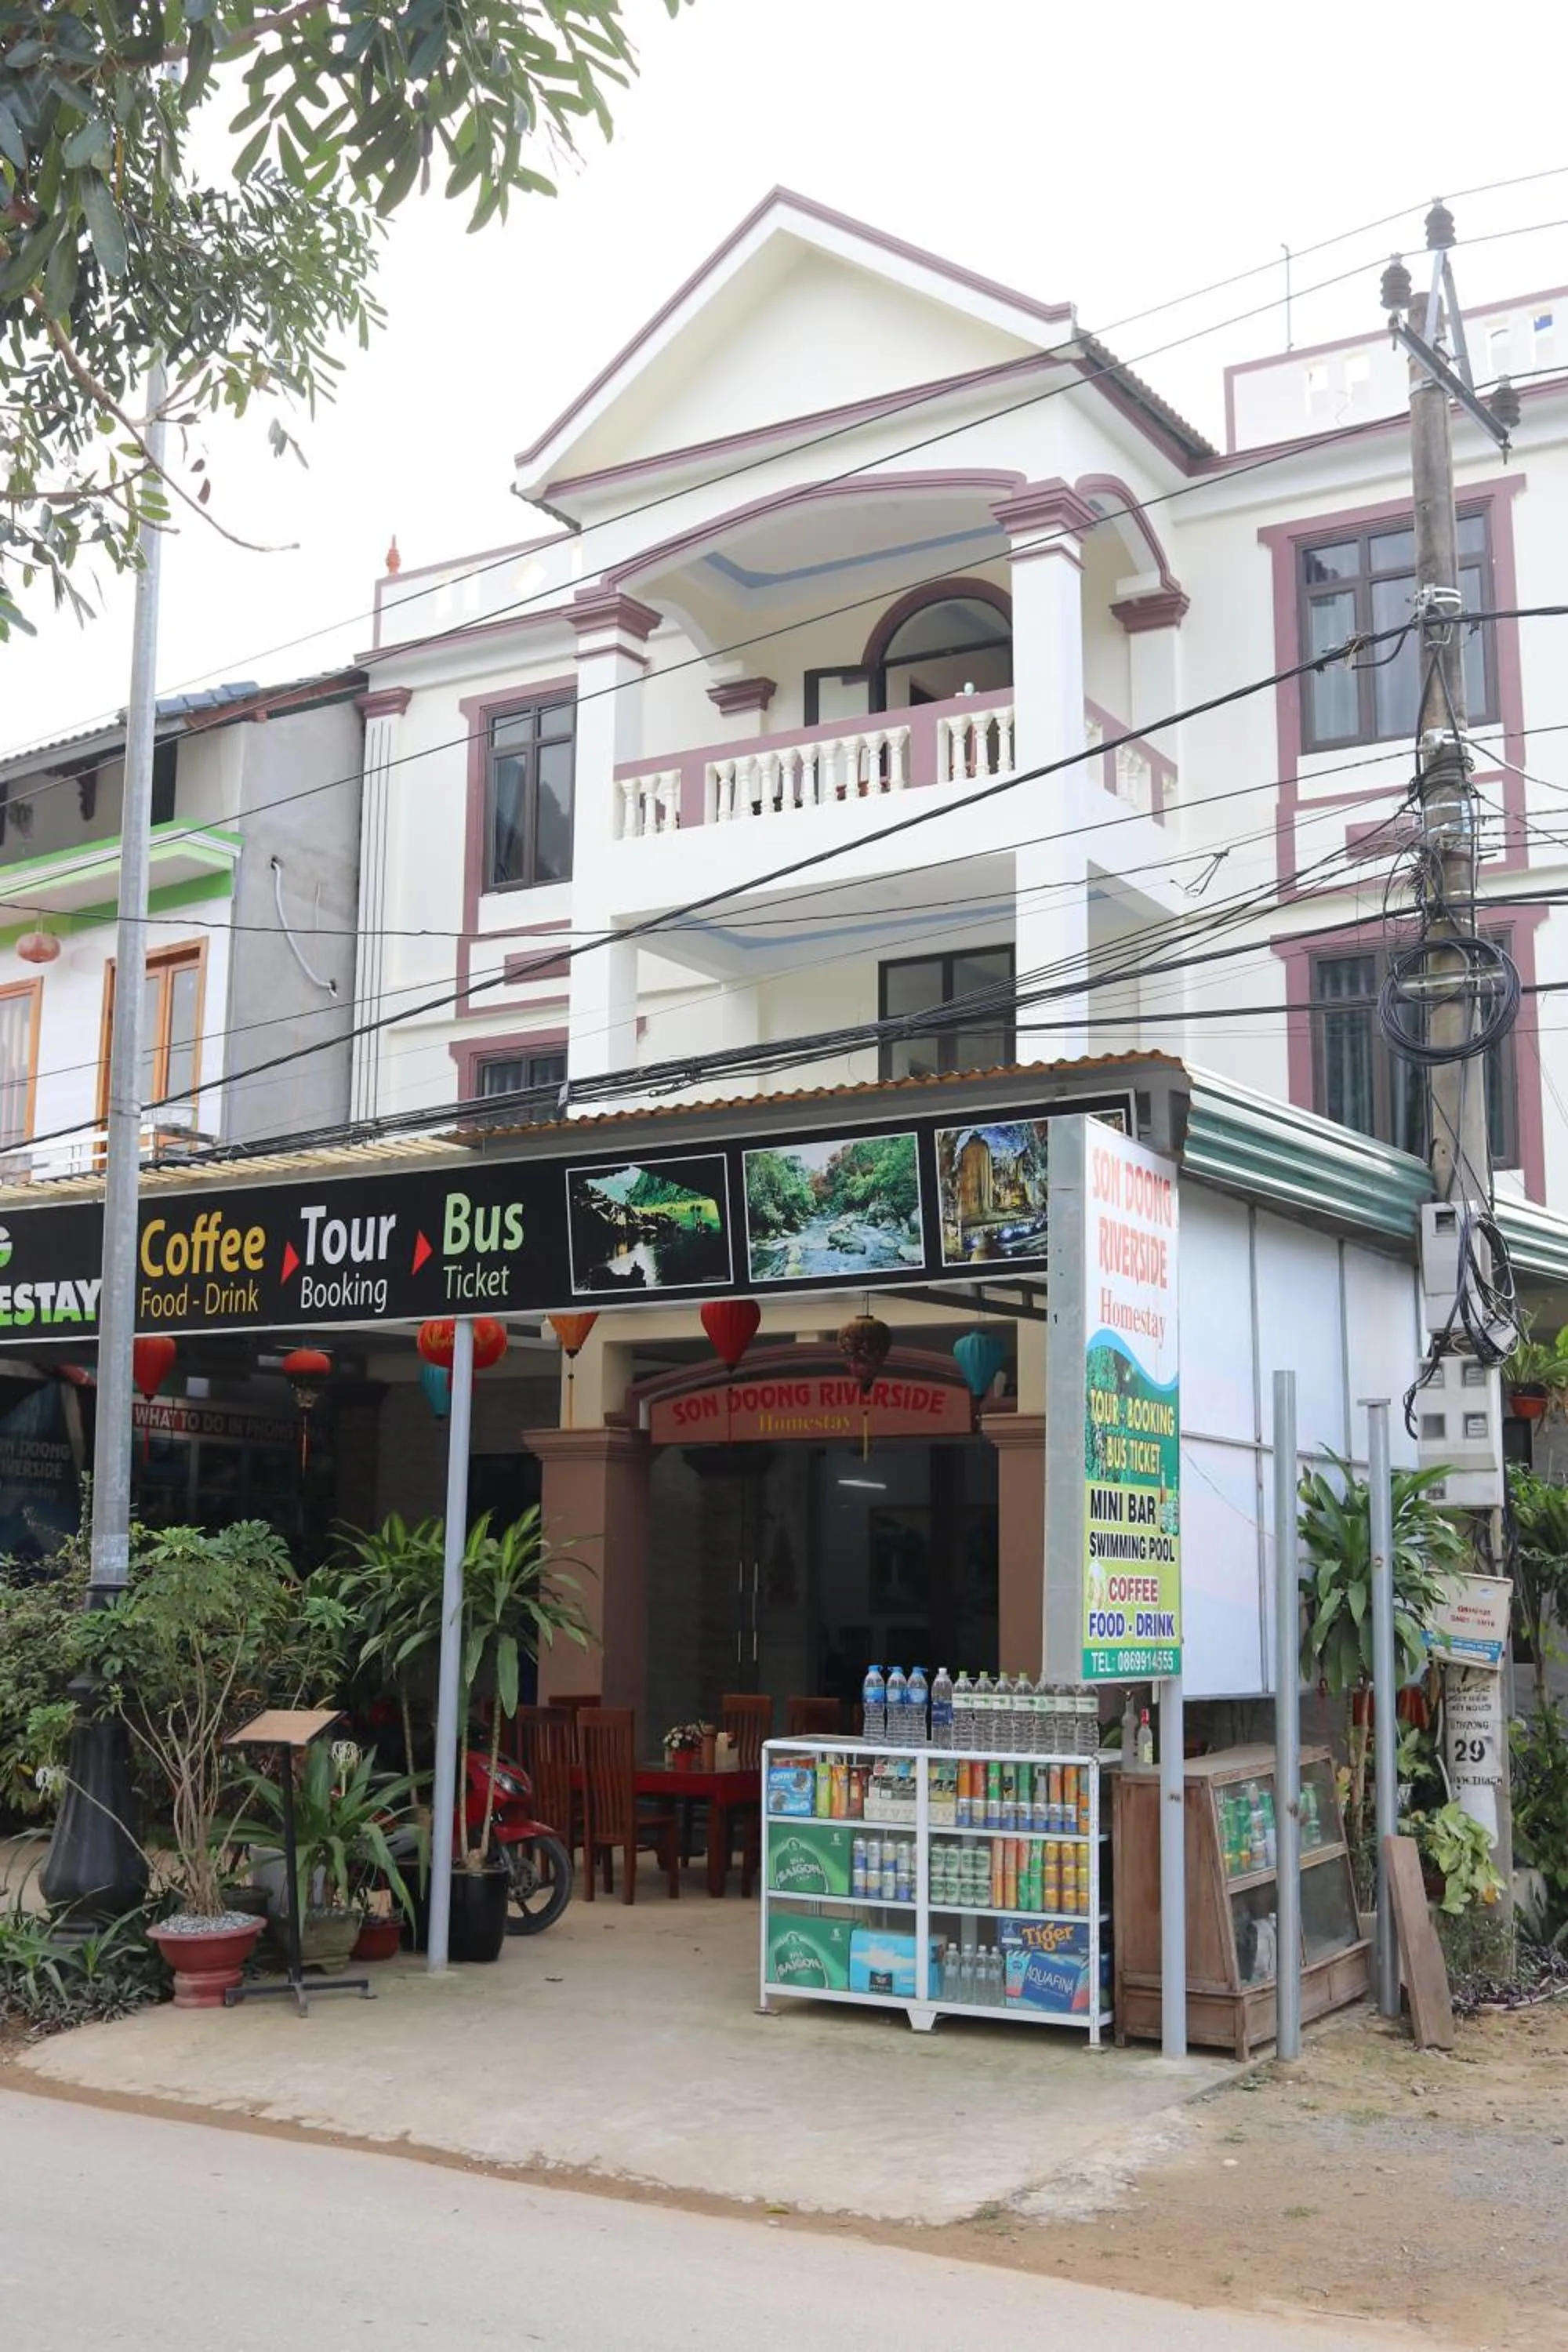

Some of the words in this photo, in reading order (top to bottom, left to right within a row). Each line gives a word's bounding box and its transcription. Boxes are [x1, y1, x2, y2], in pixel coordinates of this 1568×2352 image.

[1092, 1147, 1121, 1209] SON
[1125, 1162, 1172, 1229] DOONG
[299, 1205, 397, 1266] Tour
[442, 1192, 524, 1255] Bus
[140, 1210, 267, 1277] Coffee
[1099, 1215, 1167, 1290] RIVERSIDE
[140, 1282, 189, 1318] Food
[205, 1279, 260, 1316] Drink
[300, 1276, 388, 1314] Booking
[443, 1263, 510, 1300] Ticket
[1101, 1287, 1167, 1349] Homestay
[134, 1405, 176, 1428] WHAT
[180, 1409, 201, 1430] TO
[202, 1414, 224, 1432] DO
[672, 1392, 718, 1426] SON
[727, 1383, 811, 1414] DOONG
[1091, 1388, 1119, 1426] TOUR
[1127, 1397, 1174, 1437] BOOKING
[759, 1414, 851, 1436] Homestay
[1106, 1436, 1127, 1469] BUS
[1130, 1439, 1160, 1475] TICKET
[1091, 1489, 1123, 1523] MINI
[1128, 1494, 1156, 1526] BAR
[1089, 1531, 1146, 1561] SWIMMING
[1149, 1537, 1175, 1563] POOL
[1108, 1576, 1159, 1603] COFFEE
[1089, 1612, 1125, 1639] FOOD
[1136, 1612, 1175, 1639] DRINK
[1454, 1738, 1486, 1763] 29
[1022, 1922, 1074, 1951] Tiger
[1025, 1964, 1074, 1996] AQUAFINA
